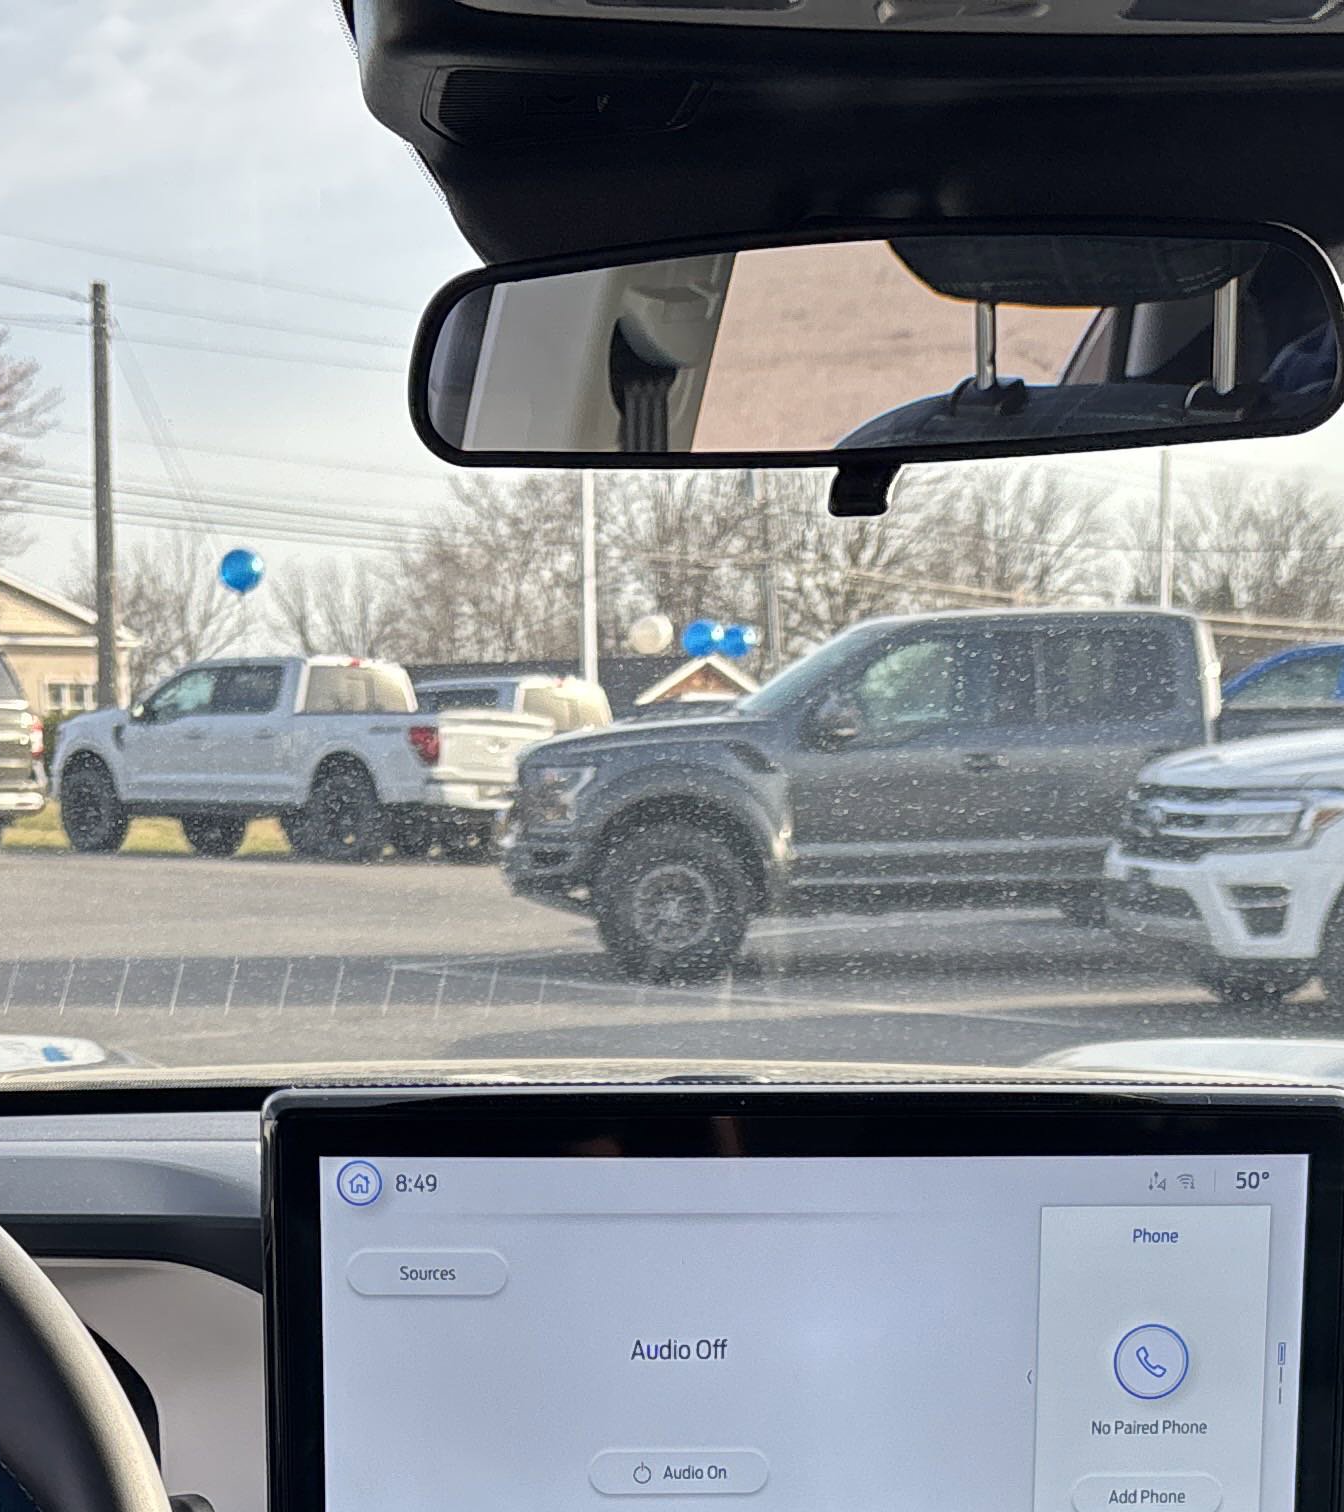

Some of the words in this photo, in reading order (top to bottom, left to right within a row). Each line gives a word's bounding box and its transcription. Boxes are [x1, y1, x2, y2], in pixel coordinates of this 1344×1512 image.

[395, 1173, 437, 1193] 8:49
[1132, 1228, 1179, 1244] Phone
[399, 1265, 456, 1281] Sources
[630, 1338, 691, 1361] Audio
[696, 1338, 728, 1360] Off
[1091, 1420, 1112, 1436] No
[1114, 1420, 1159, 1435] Paired
[1162, 1420, 1208, 1435] Phone
[663, 1465, 704, 1480] Audio
[707, 1465, 727, 1480] On
[1108, 1489, 1138, 1504] Add
[1140, 1489, 1186, 1504] Phone
